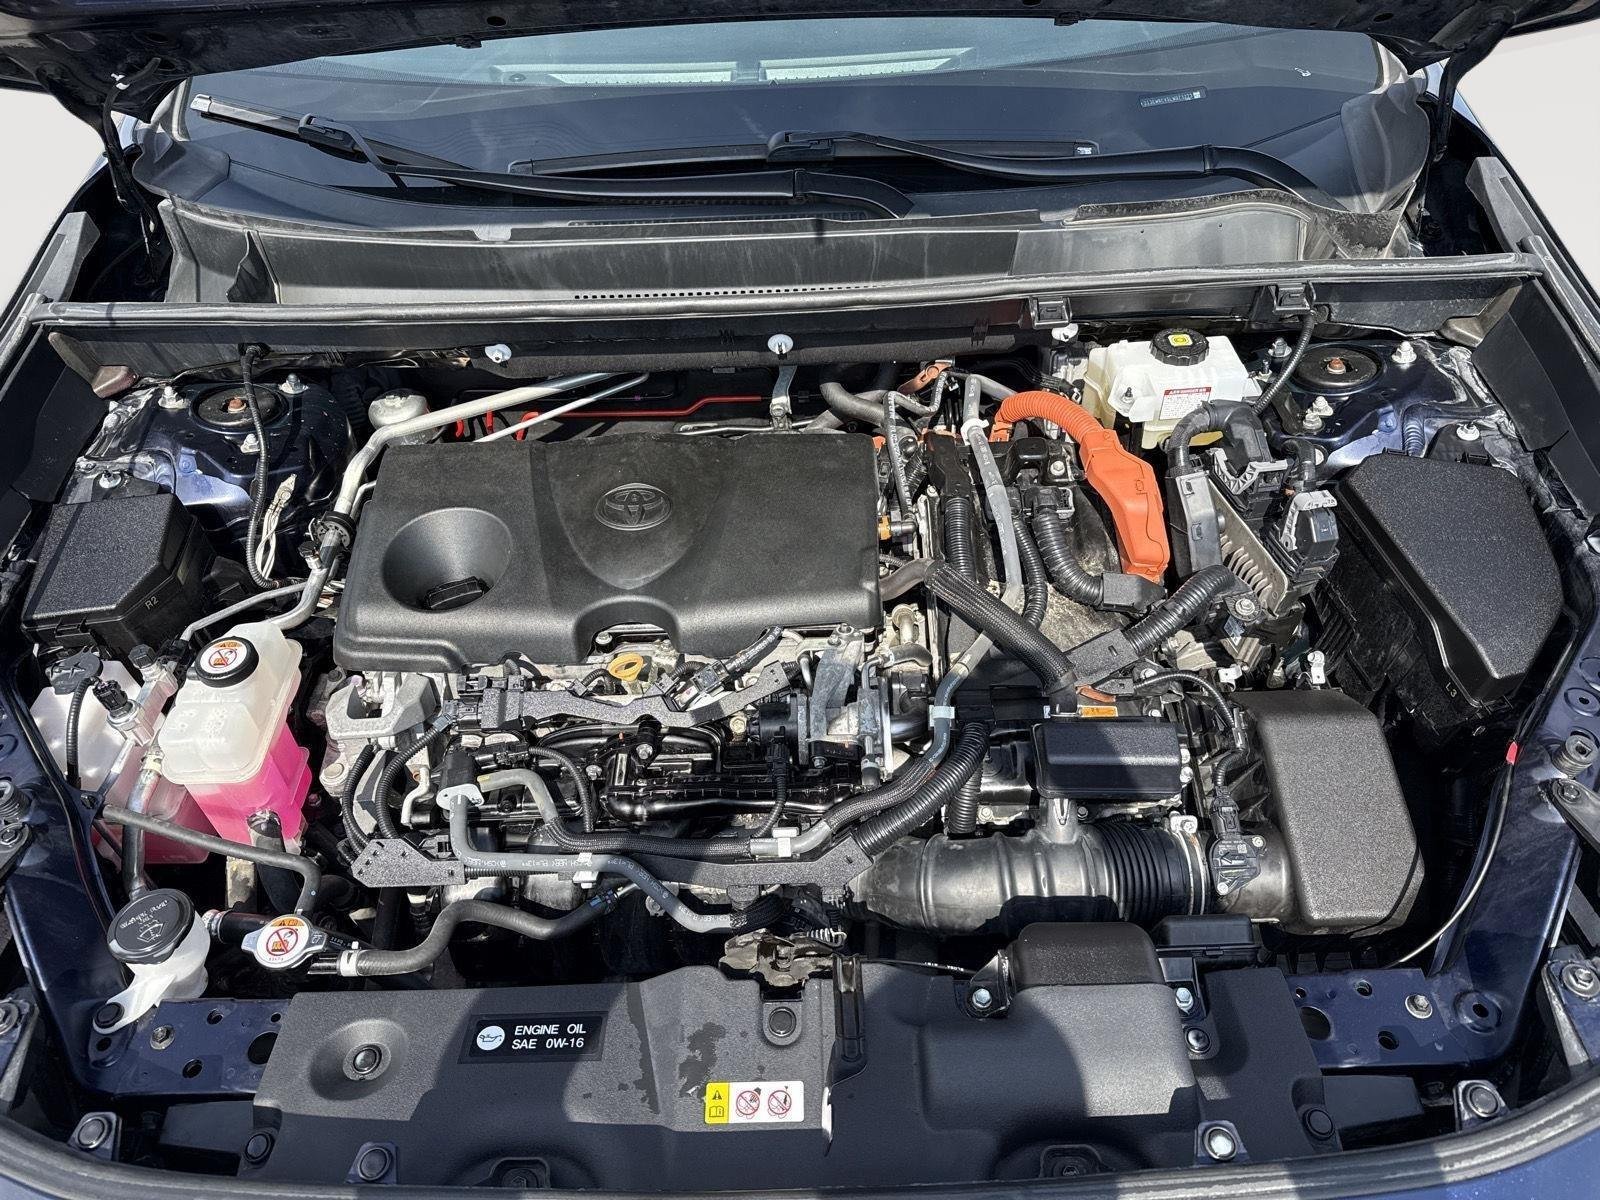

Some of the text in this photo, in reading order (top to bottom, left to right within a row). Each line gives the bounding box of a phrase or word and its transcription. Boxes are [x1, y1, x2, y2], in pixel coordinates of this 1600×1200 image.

[145, 596, 159, 610] R2
[514, 1023, 587, 1036] ENGINE OIL
[511, 1037, 585, 1050] SAE 0W-16
